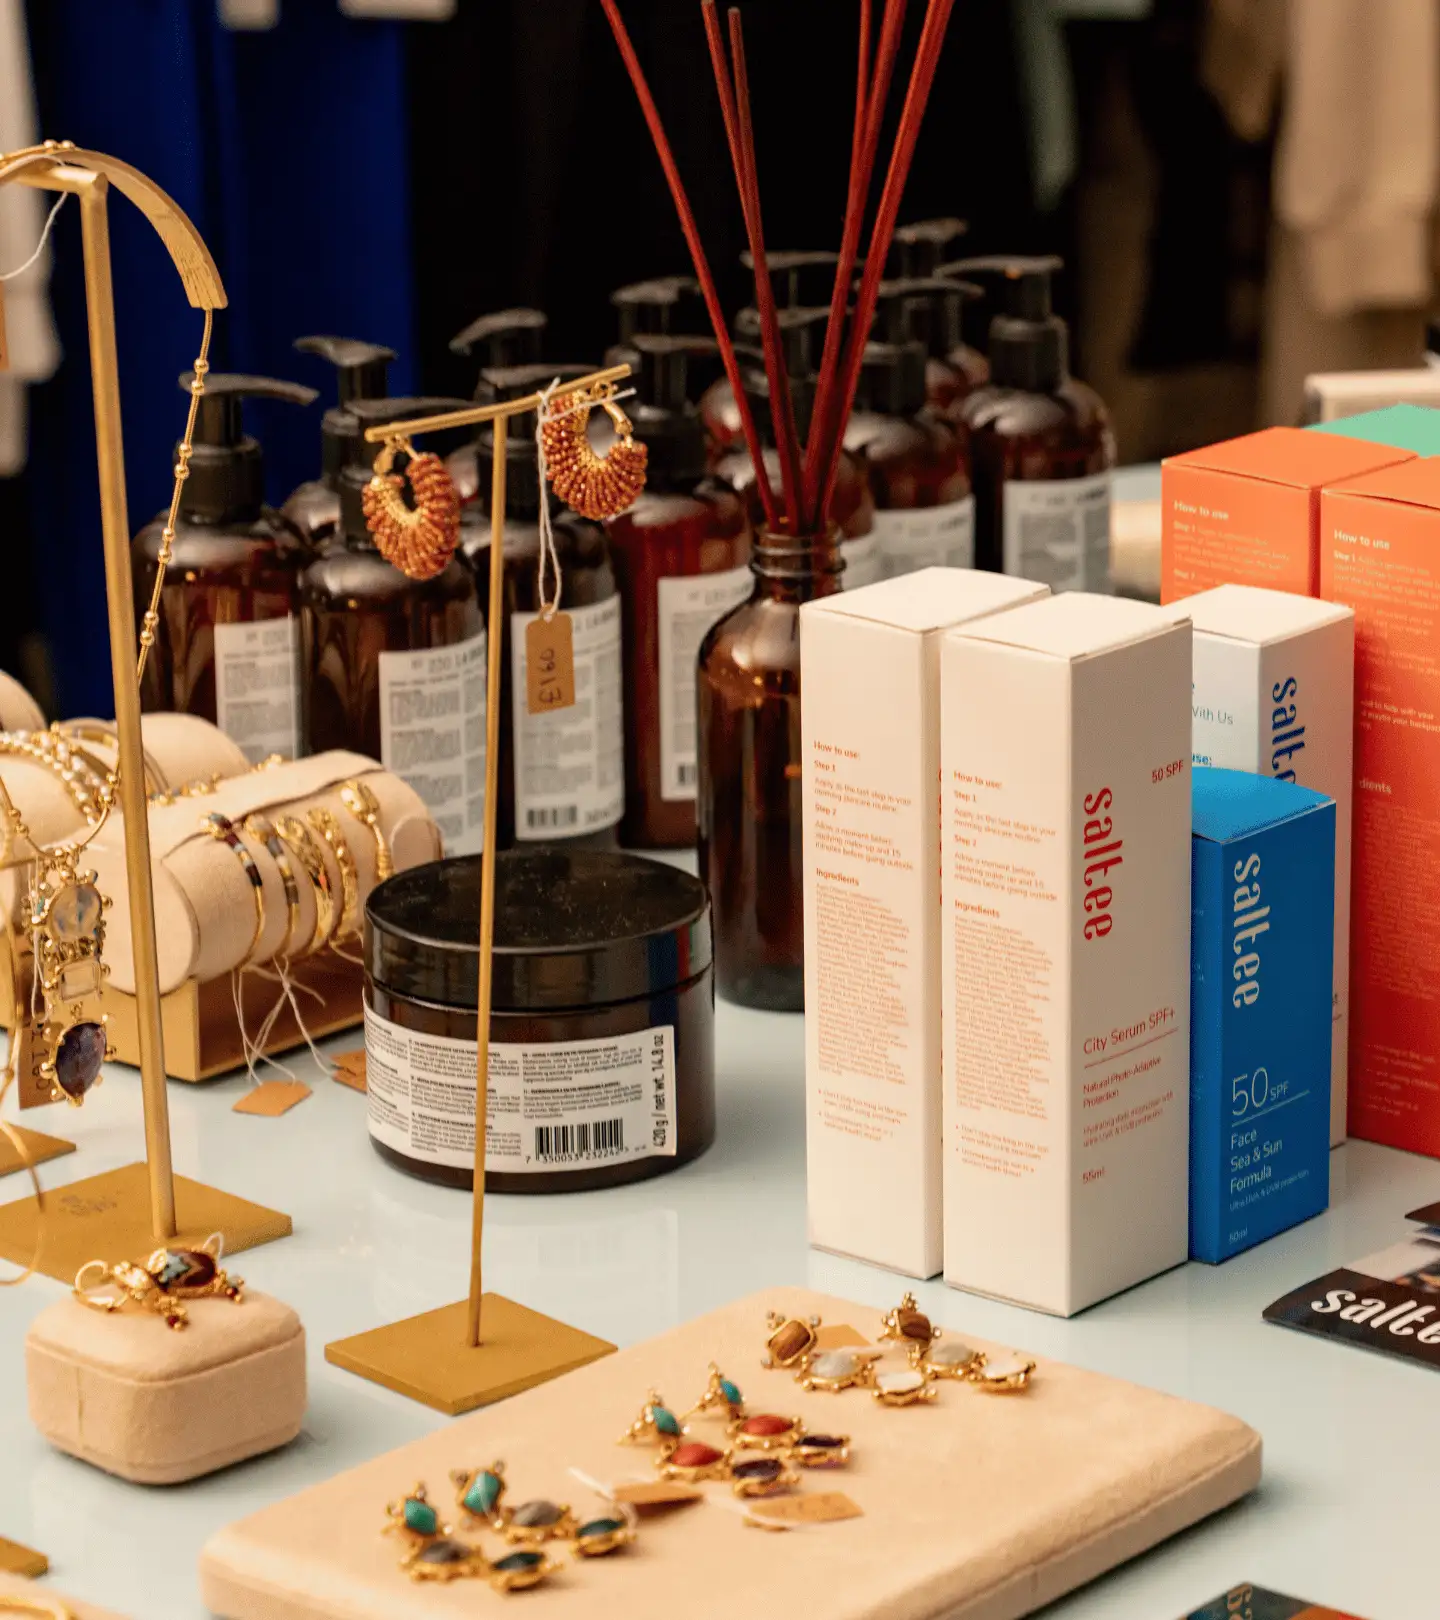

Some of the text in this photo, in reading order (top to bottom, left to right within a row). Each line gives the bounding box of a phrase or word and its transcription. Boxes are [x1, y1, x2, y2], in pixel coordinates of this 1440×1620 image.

[1174, 500, 1228, 520] How to use
[1334, 529, 1390, 550] How to use
[538, 648, 562, 704] £160
[1217, 710, 1234, 725] Us
[814, 740, 832, 753] How
[834, 746, 842, 755] to
[814, 760, 830, 772] Step
[1152, 759, 1184, 784] 50 SPF
[954, 770, 972, 784] How
[974, 776, 984, 785] to
[1360, 778, 1392, 794] dients
[954, 790, 970, 802] Step
[814, 802, 830, 815] Step
[954, 834, 970, 847] Step
[1084, 787, 1123, 940] saltee
[816, 867, 860, 886] Ingredients
[954, 899, 1000, 918] Ingredients
[1232, 853, 1270, 1008] saltee
[1084, 1006, 1176, 1054] City Serum SPF+
[654, 1034, 664, 1047] oz
[1083, 1055, 1162, 1094] Natural Photo-Adaptive
[1083, 1089, 1120, 1110] Protection
[1232, 1066, 1289, 1116] 50 SPF
[652, 1128, 666, 1147] 420
[1230, 1128, 1257, 1150] Face
[526, 1155, 531, 1164] 7
[543, 1153, 580, 1164] 350053
[1230, 1138, 1283, 1173] Sea & Sun
[1230, 1164, 1272, 1196] Formula
